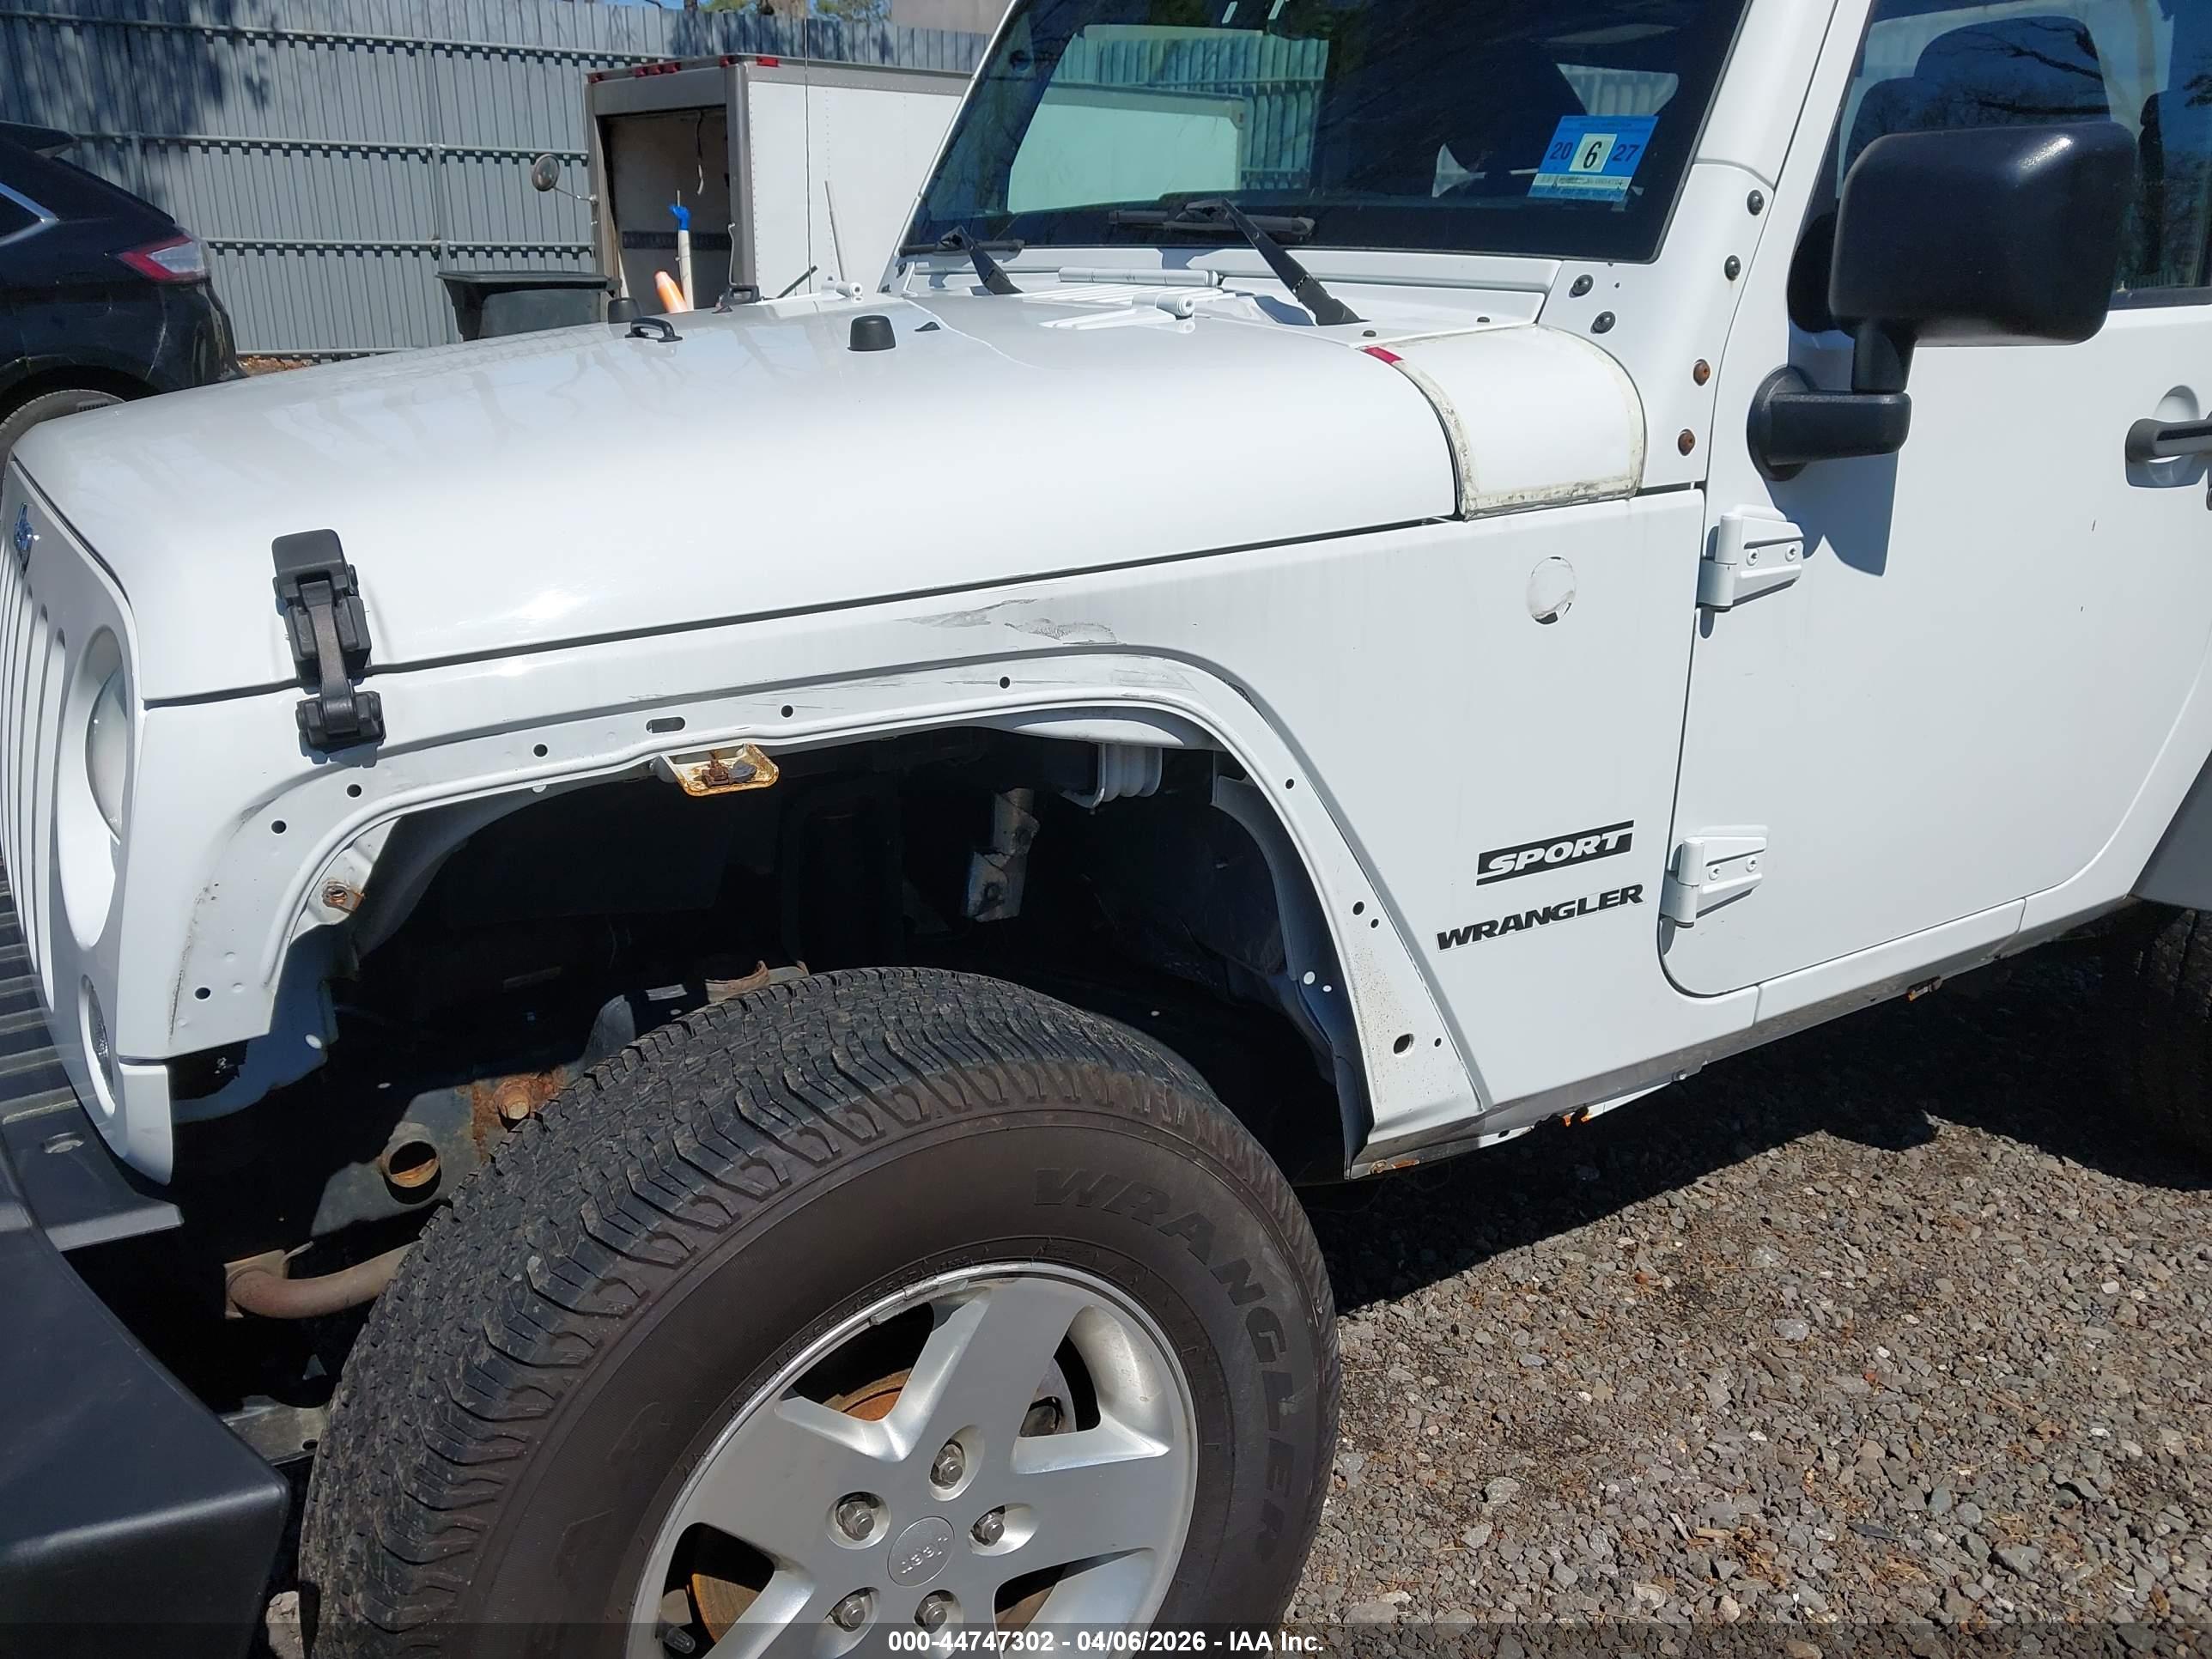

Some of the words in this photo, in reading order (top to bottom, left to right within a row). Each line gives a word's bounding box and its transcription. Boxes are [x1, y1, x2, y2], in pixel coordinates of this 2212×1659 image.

[1549, 142, 1573, 161] 20
[1583, 141, 1602, 169] 6
[1612, 144, 1639, 162] 27
[1485, 826, 1633, 876] SPORT
[1436, 884, 1644, 951] WRANGLER
[1033, 1167, 1295, 1564] WRANGLER
